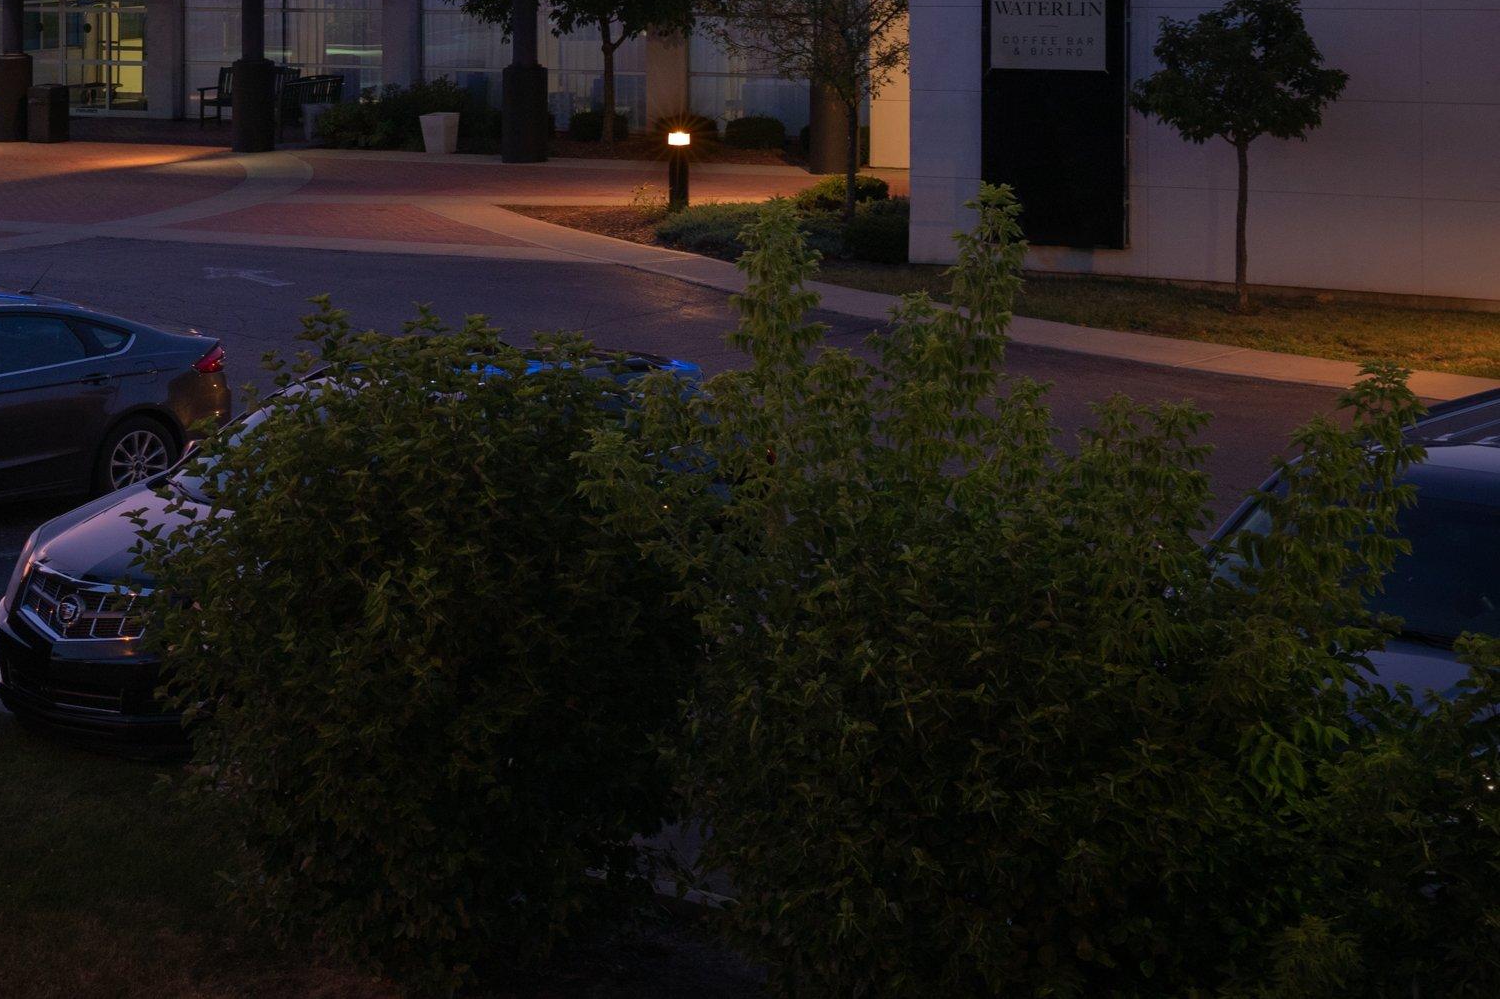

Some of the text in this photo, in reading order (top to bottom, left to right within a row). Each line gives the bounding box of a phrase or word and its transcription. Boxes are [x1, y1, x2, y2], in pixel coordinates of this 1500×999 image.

[994, 1, 1103, 17] WATERLIN
[1002, 35, 1094, 46] COFFEE BAR
[1013, 47, 1083, 57] & BISTRO
